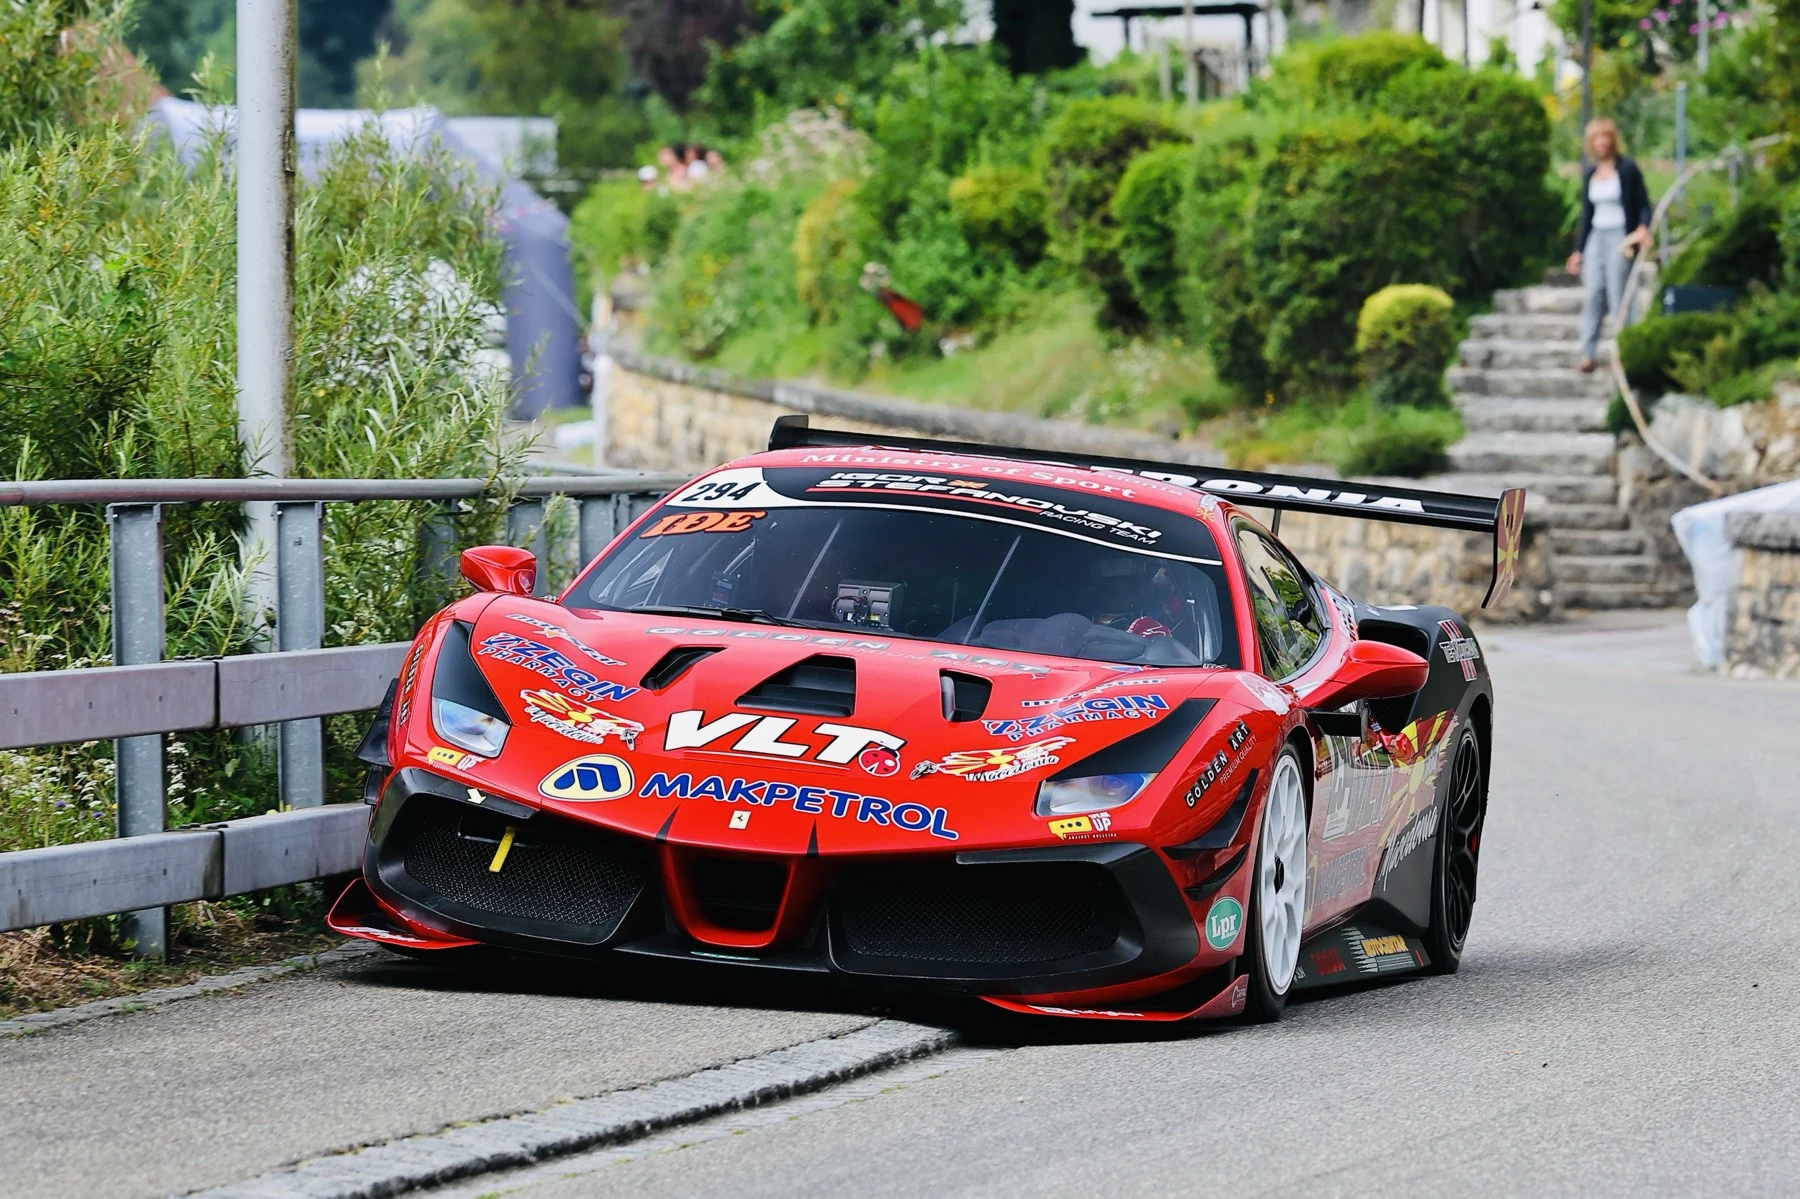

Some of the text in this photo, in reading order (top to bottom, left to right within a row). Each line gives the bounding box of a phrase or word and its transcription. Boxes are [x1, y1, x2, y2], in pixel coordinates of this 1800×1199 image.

[681, 482, 761, 502] 294
[800, 454, 974, 470] Ministry
[980, 464, 1020, 476] of
[1028, 470, 1138, 499] Sport
[830, 472, 948, 485] IGOR
[1038, 510, 1157, 545] RACING TEAM
[645, 627, 893, 650] GOLDEN
[928, 650, 1053, 675] ART
[477, 647, 605, 702] PHARMACY
[511, 641, 642, 702] ZEGIN
[1008, 708, 1158, 742] PHARMACY
[1019, 694, 1171, 731] ZEGIN
[664, 709, 908, 765] VLT
[1239, 734, 1257, 760] QUALITY
[1185, 722, 1250, 808] GOLDEN ART
[638, 772, 959, 841] MAKPETROL
[1091, 816, 1112, 832] UP
[1210, 913, 1237, 941] Lpr
